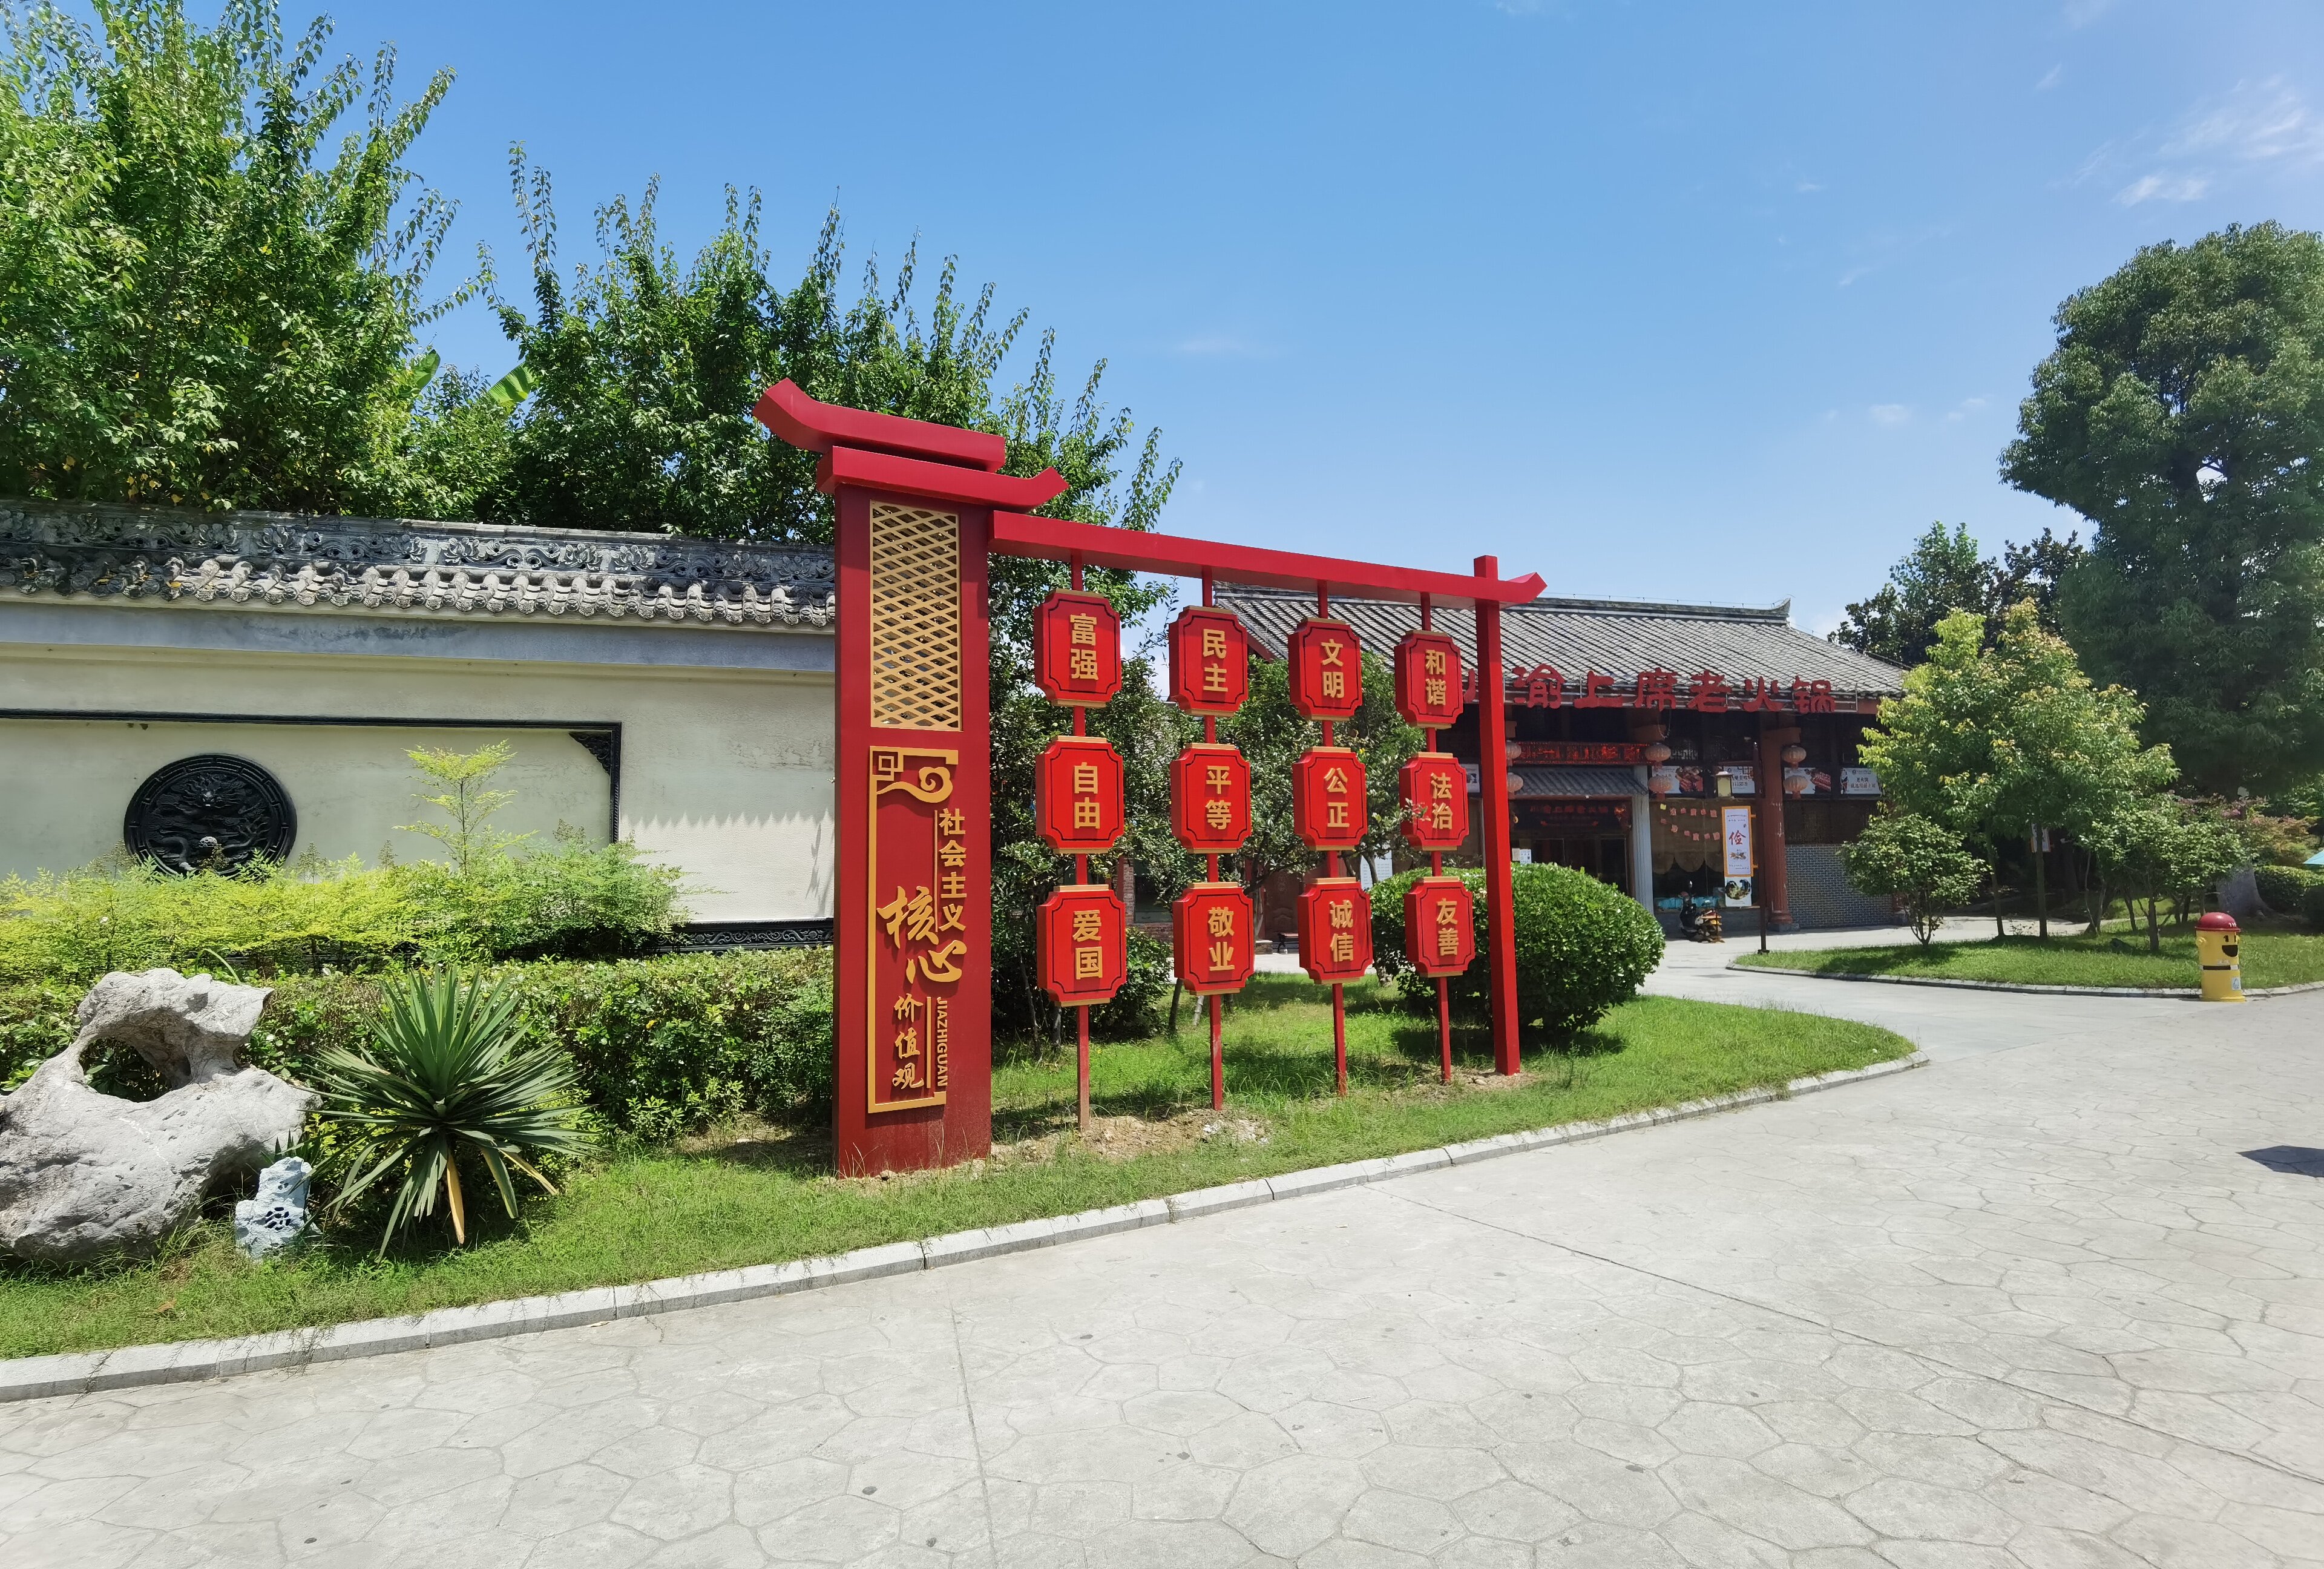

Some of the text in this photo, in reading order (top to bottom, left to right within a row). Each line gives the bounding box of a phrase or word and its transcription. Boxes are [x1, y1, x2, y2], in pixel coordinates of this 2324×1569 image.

[1070, 613, 1098, 680] 富强
[1203, 628, 1228, 692] 民主
[1321, 639, 1344, 699] 文明
[1425, 650, 1446, 706] 和谐
[1074, 761, 1100, 829] 自由
[1206, 765, 1232, 830] 平等
[1324, 767, 1349, 827] 公正
[1430, 772, 1452, 830] 法治
[939, 808, 967, 932] 社会主义
[877, 886, 967, 984] 核心
[1072, 909, 1103, 979] 爱国
[1208, 907, 1235, 971] 敬业
[1330, 900, 1354, 962] 诚信
[1436, 898, 1459, 956] 友善
[893, 993, 924, 1090] 价值观
[936, 996, 948, 1087] JIAZHIGUAN
